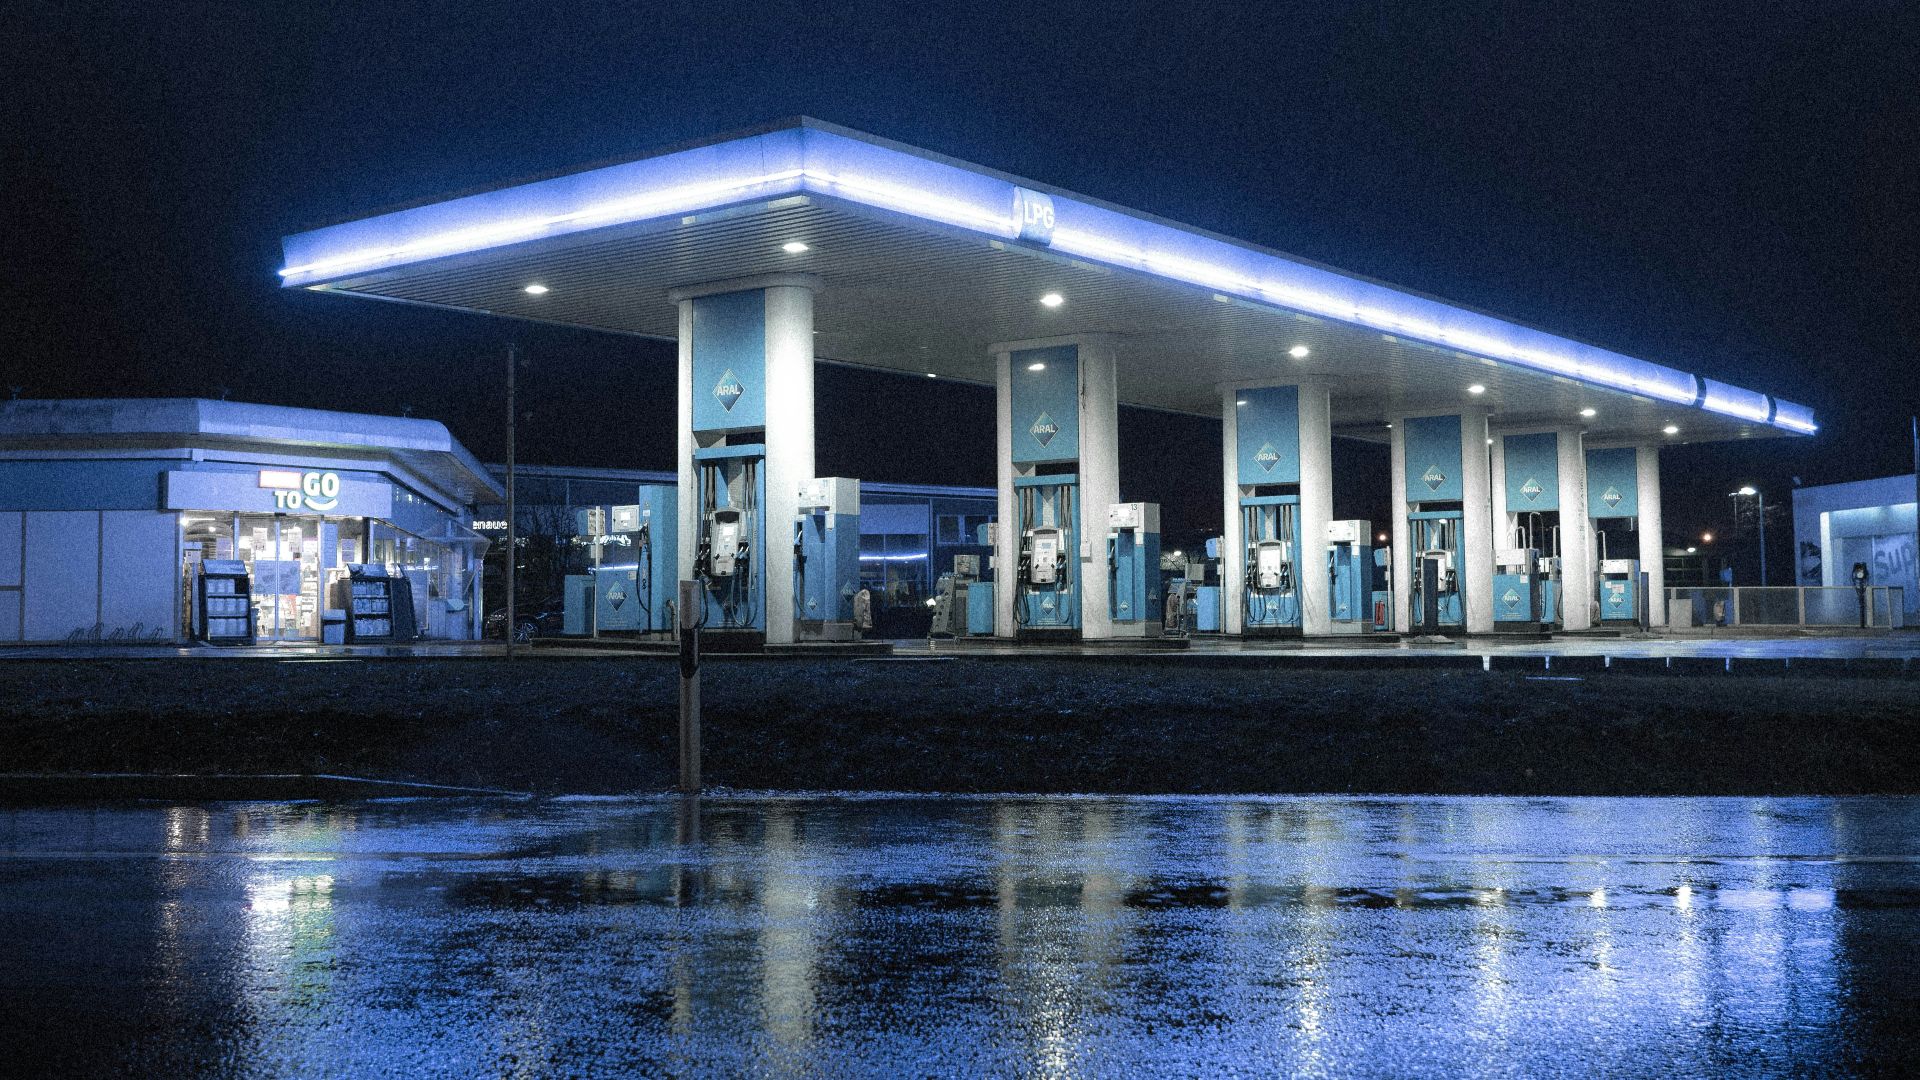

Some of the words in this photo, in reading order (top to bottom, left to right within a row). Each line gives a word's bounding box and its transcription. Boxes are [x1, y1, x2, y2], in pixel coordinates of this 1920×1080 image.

[1024, 201, 1054, 229] LPG
[717, 384, 740, 396] ARAL
[1033, 424, 1055, 434] ARAL
[1257, 452, 1278, 461] ARAL
[1424, 473, 1443, 482] ARAL
[274, 490, 302, 509] TO
[303, 472, 340, 498] GO
[1130, 503, 1138, 511] 13
[608, 592, 625, 600] ARAL
